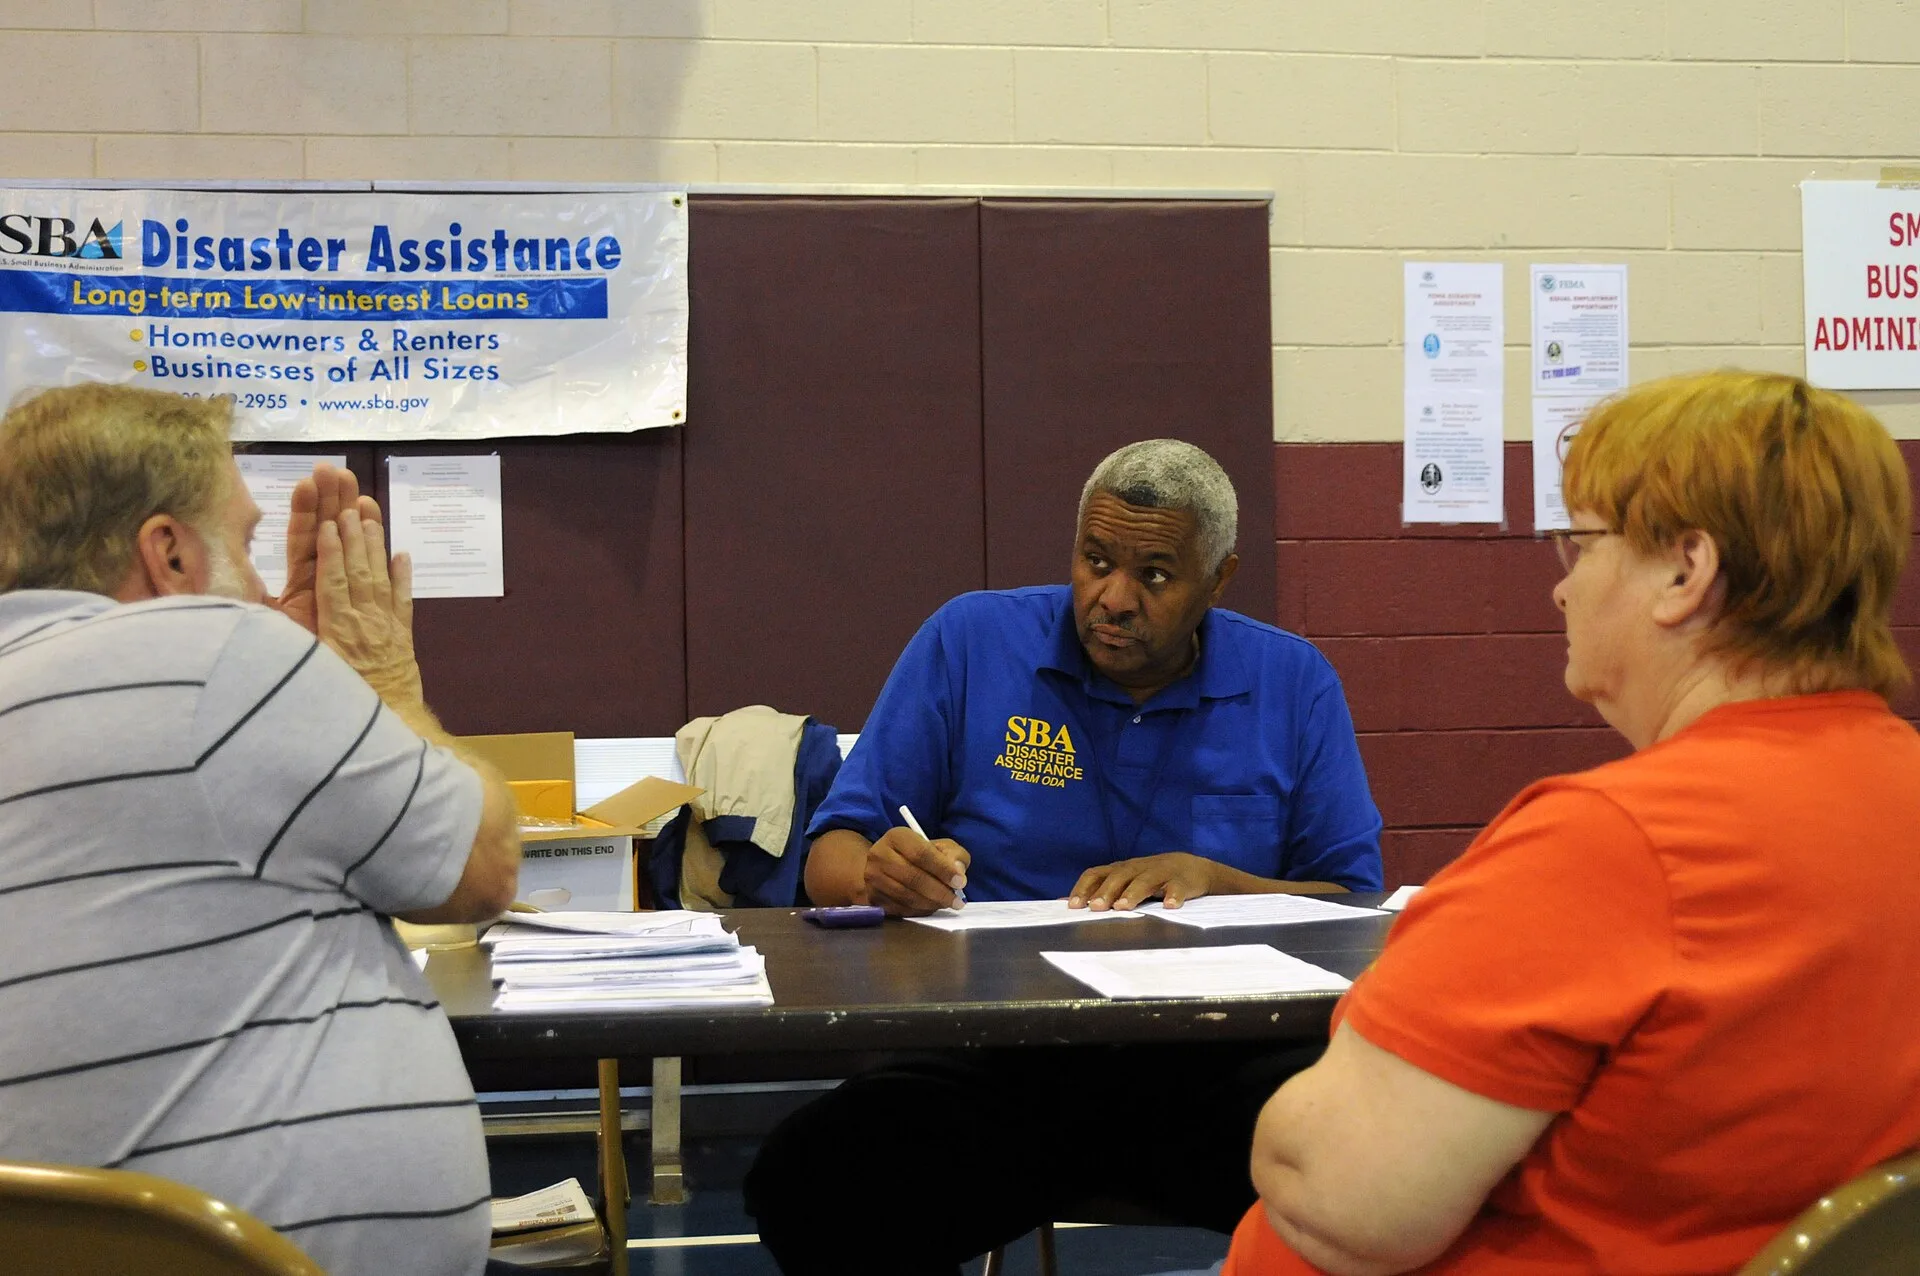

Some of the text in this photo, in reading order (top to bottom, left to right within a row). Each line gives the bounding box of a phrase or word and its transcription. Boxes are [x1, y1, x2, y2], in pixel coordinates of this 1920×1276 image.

[0, 214, 122, 259] SBA
[142, 218, 622, 273] Disaster Assistance
[11, 259, 32, 267] Small
[34, 260, 67, 269] Business
[68, 263, 124, 272] Administration
[72, 281, 529, 314] Long-term Low-interest Loans
[149, 325, 500, 351] Homeowners & Renters
[1814, 317, 1920, 351] ADMINI
[151, 355, 500, 383] Businesses of All Sizes
[319, 394, 430, 412] www.sba.gov
[1005, 715, 1076, 753] SBA
[994, 754, 1083, 780] ASSISTANCE
[1006, 744, 1074, 766] DISASTER
[1010, 770, 1065, 788] TEAM ODA
[554, 849, 568, 857] ON
[571, 847, 592, 856] THIS
[595, 846, 614, 855] END
